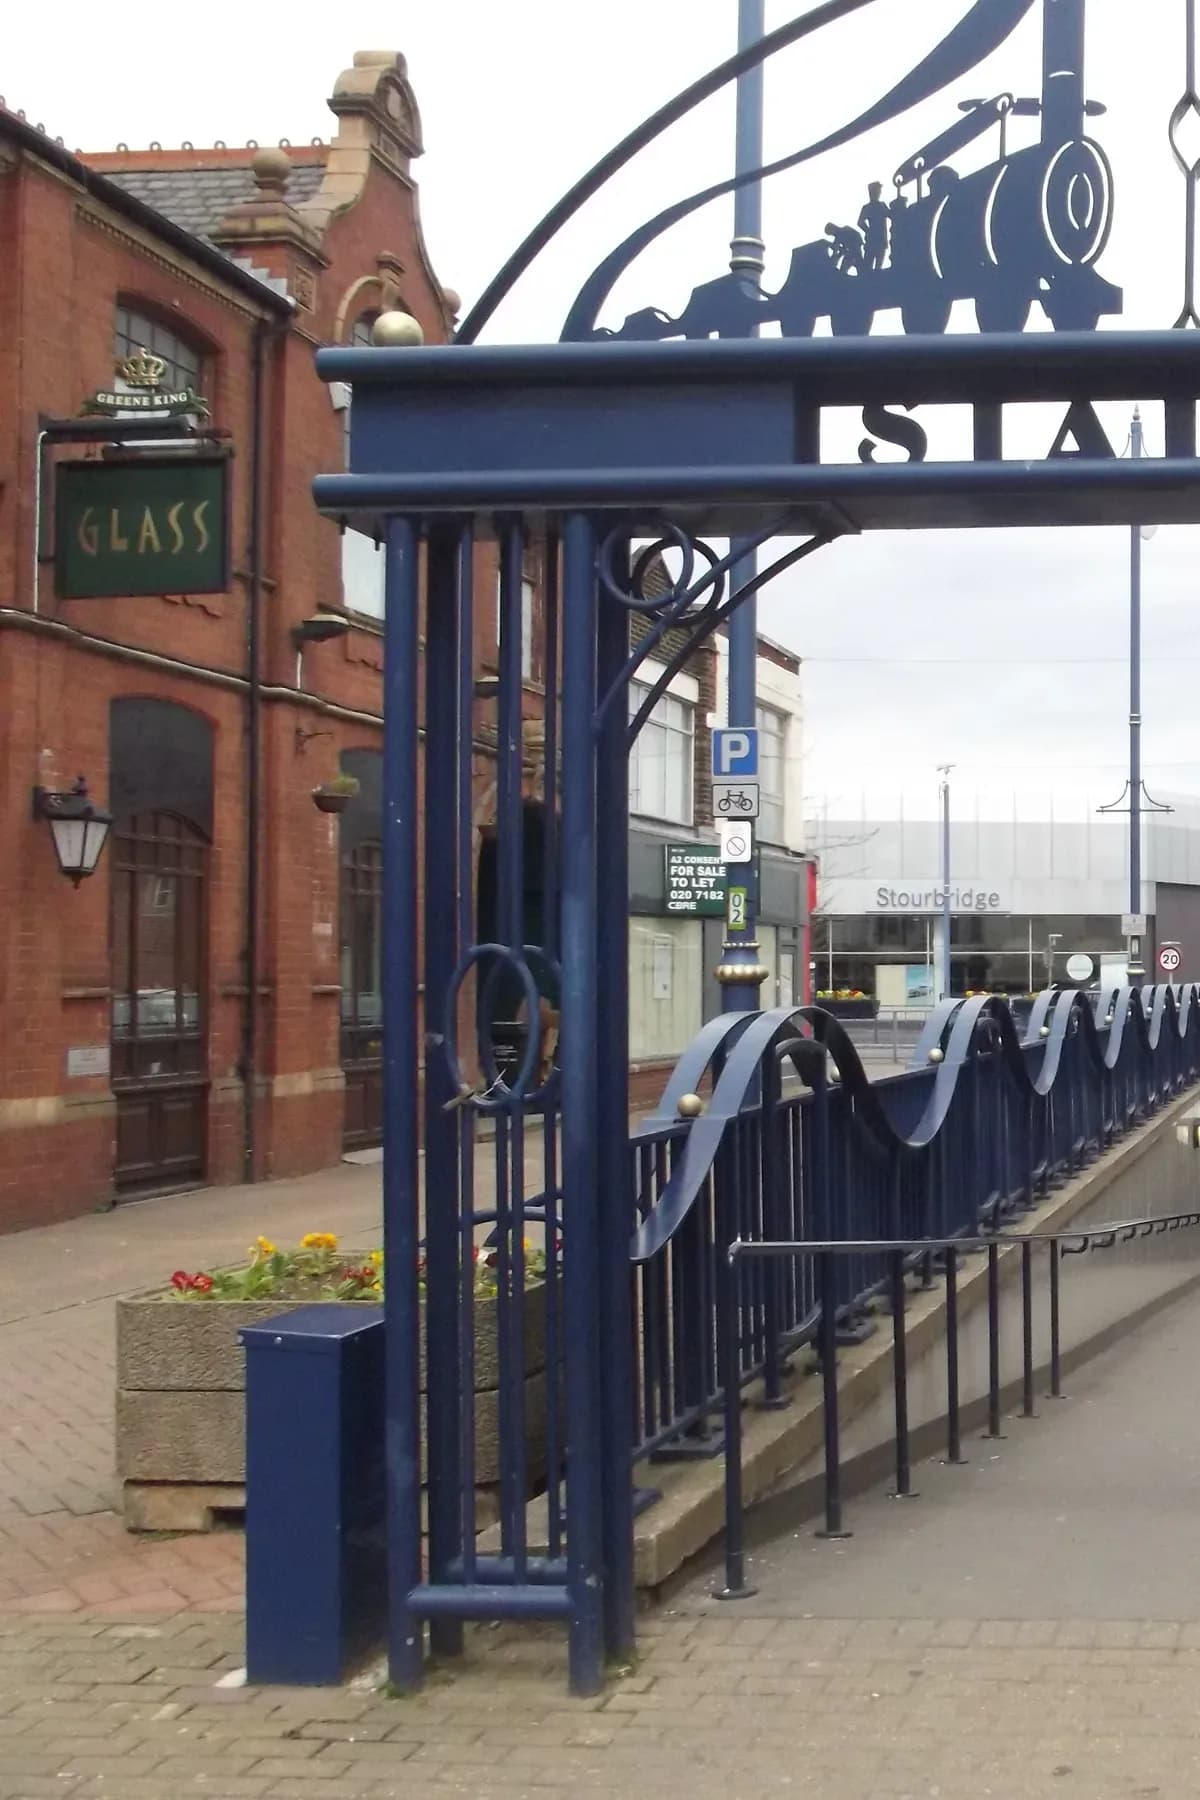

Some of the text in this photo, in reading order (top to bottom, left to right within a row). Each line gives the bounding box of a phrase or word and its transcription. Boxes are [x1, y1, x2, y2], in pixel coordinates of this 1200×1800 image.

[96, 391, 188, 406] GREENE KING
[78, 500, 210, 556] GLASS
[720, 732, 750, 773] P
[670, 856, 682, 864] A2
[670, 866, 727, 877] FOR SALE
[670, 878, 716, 888] TO LET
[670, 890, 725, 900] 020 7182
[667, 901, 697, 910] CBRE
[1162, 954, 1178, 965] 20
